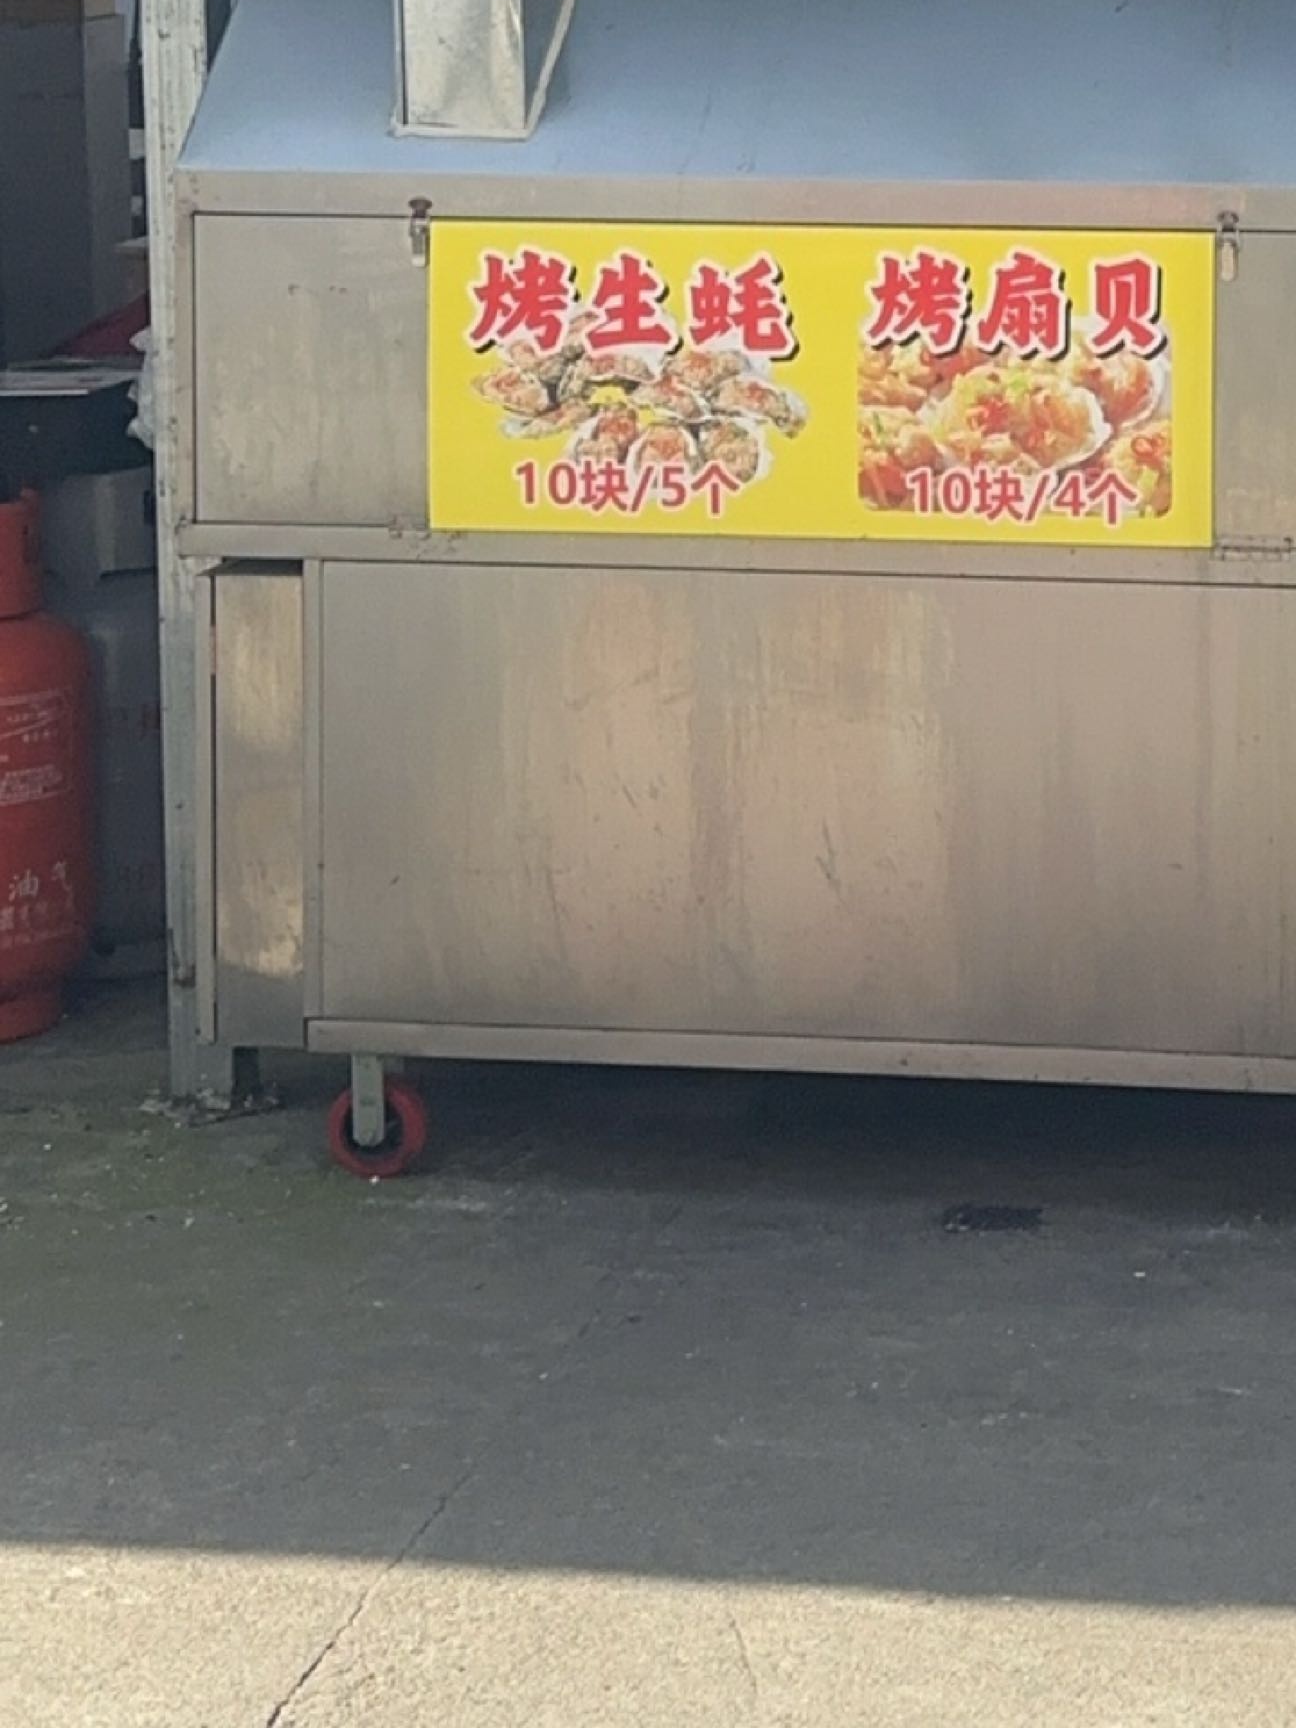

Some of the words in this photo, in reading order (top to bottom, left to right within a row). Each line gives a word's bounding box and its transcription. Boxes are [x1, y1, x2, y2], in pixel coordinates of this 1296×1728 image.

[468, 249, 796, 357] 烤生蚝
[866, 250, 1166, 360] 烤扇贝
[514, 459, 742, 515] 10块/5个
[909, 468, 1138, 526] 10块/4个
